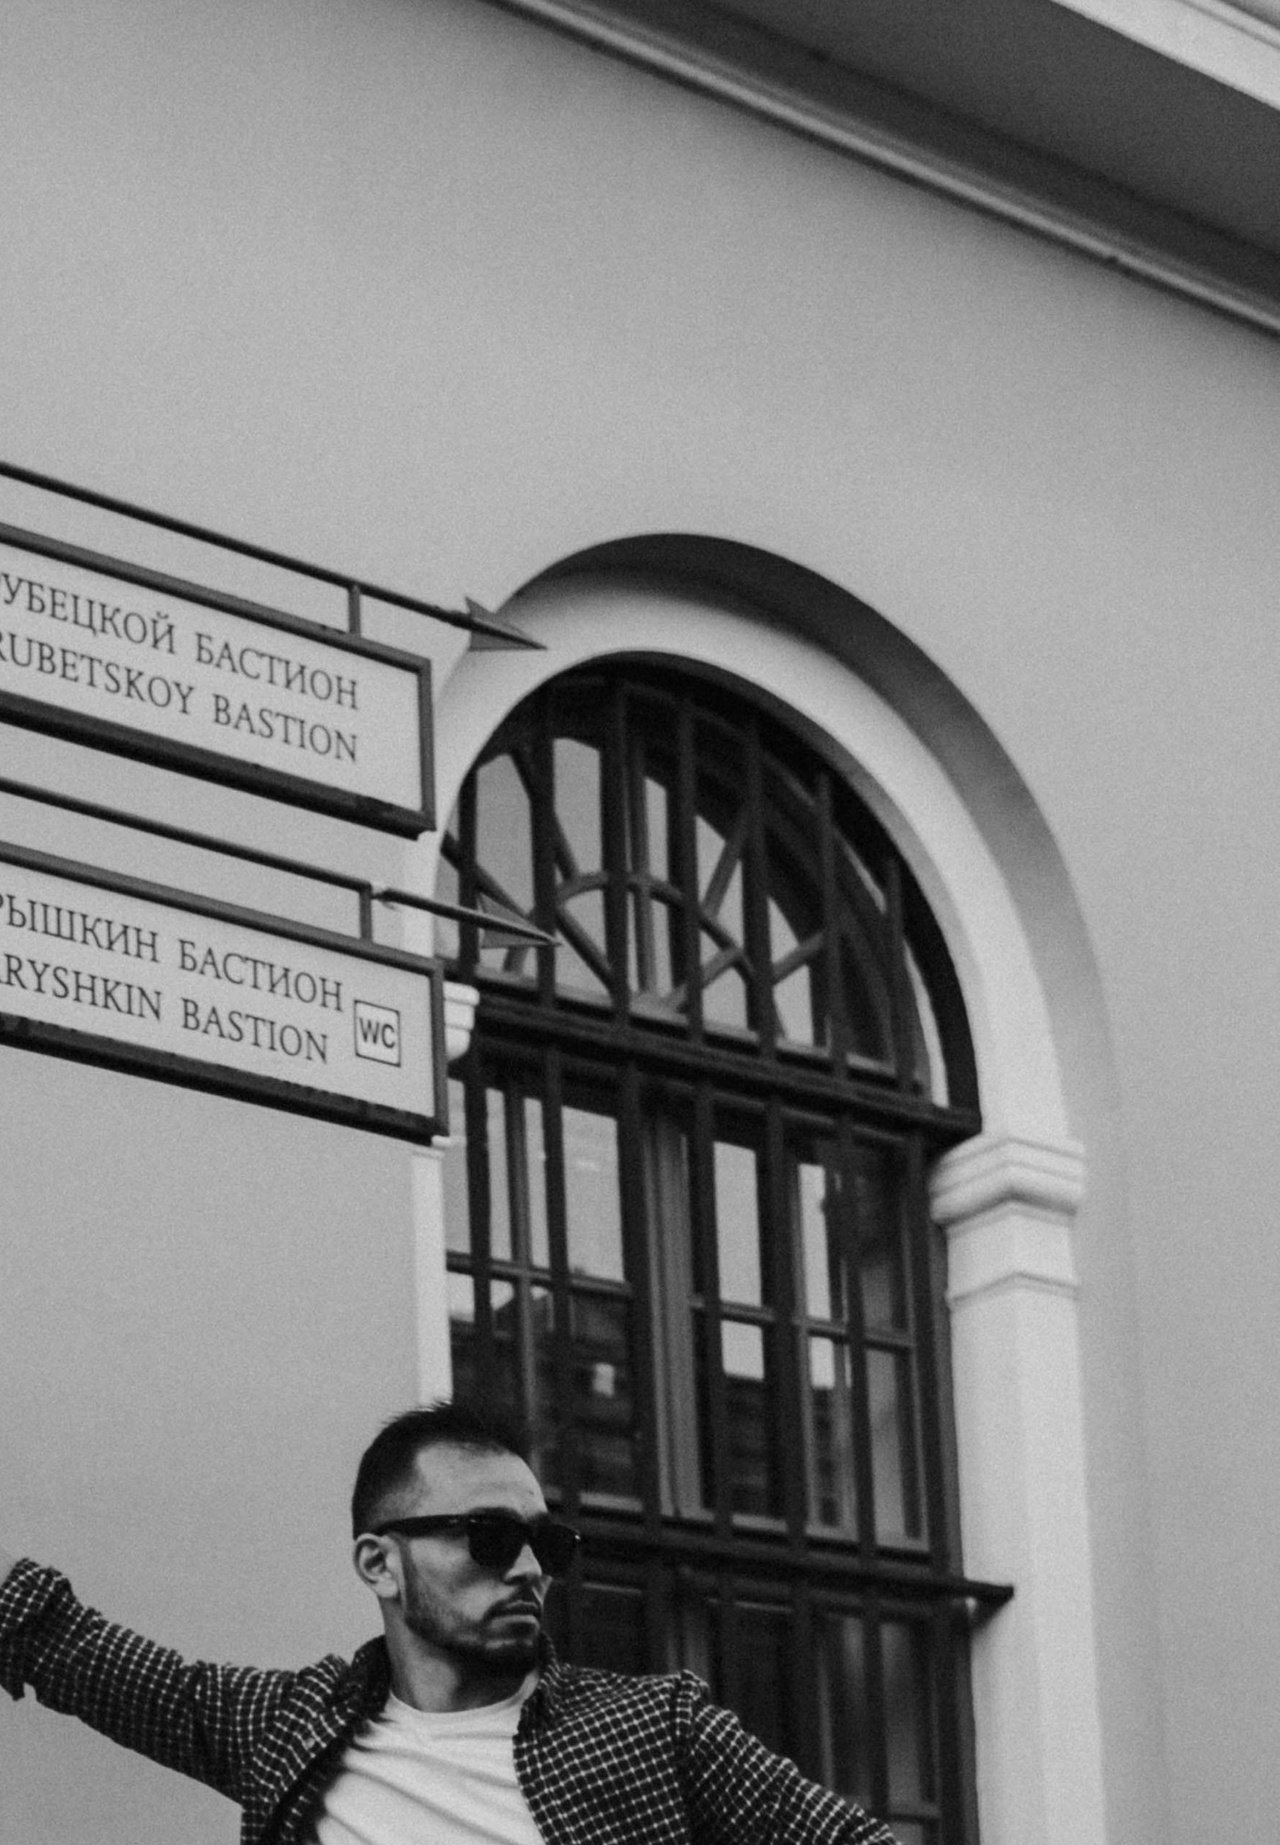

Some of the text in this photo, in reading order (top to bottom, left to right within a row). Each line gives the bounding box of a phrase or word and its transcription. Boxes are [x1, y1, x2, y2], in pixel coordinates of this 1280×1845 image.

[196, 633, 359, 709] БАСТИОН
[213, 694, 357, 761] BASTION
[178, 939, 342, 1011] БАСТИОН
[181, 998, 328, 1063] BASTION
[359, 1020, 396, 1049] WC
